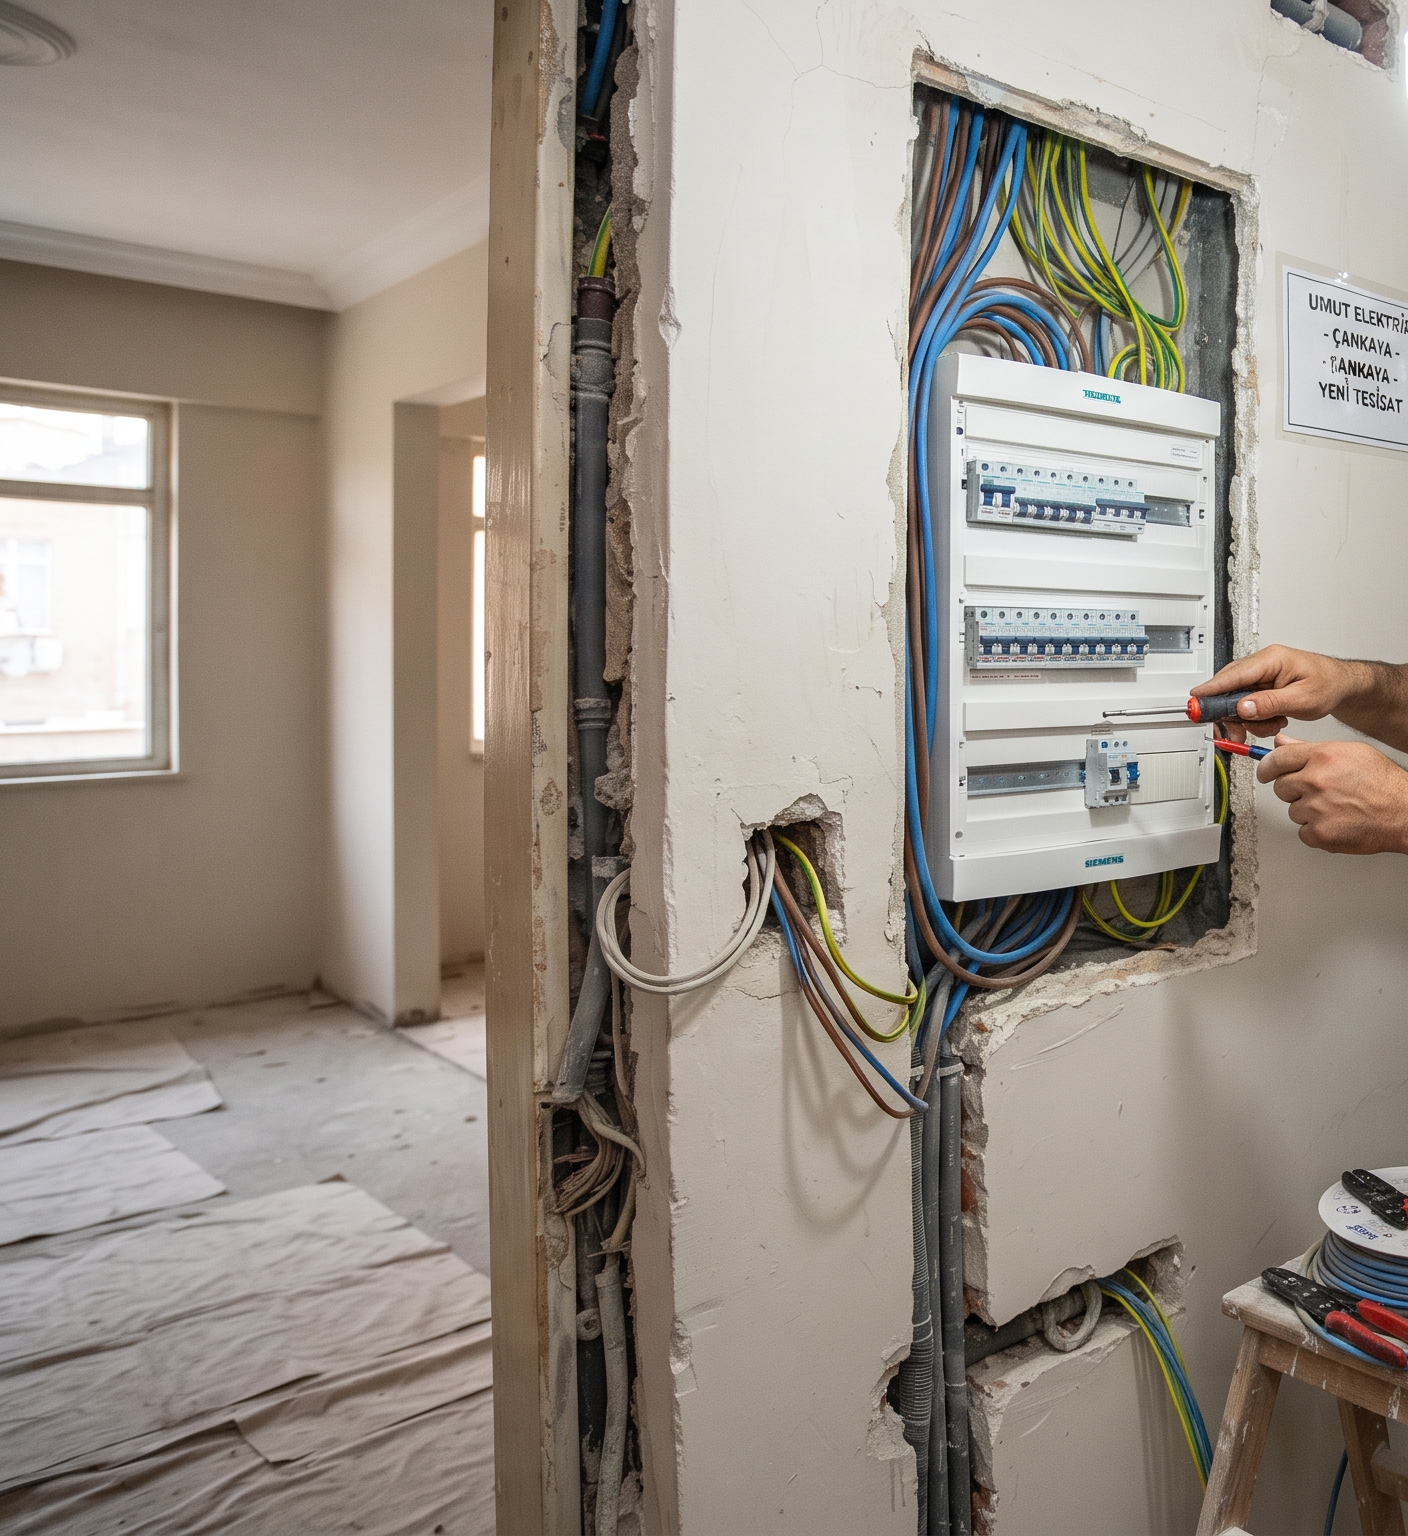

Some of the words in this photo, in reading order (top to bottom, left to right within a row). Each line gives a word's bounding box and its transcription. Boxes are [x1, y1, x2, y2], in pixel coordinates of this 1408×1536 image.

[1309, 293, 1350, 319] UMUT
[1332, 328, 1393, 358] ÇANKAYA
[1353, 385, 1403, 413] TESİSAT
[1084, 855, 1124, 868] SIEMENS
